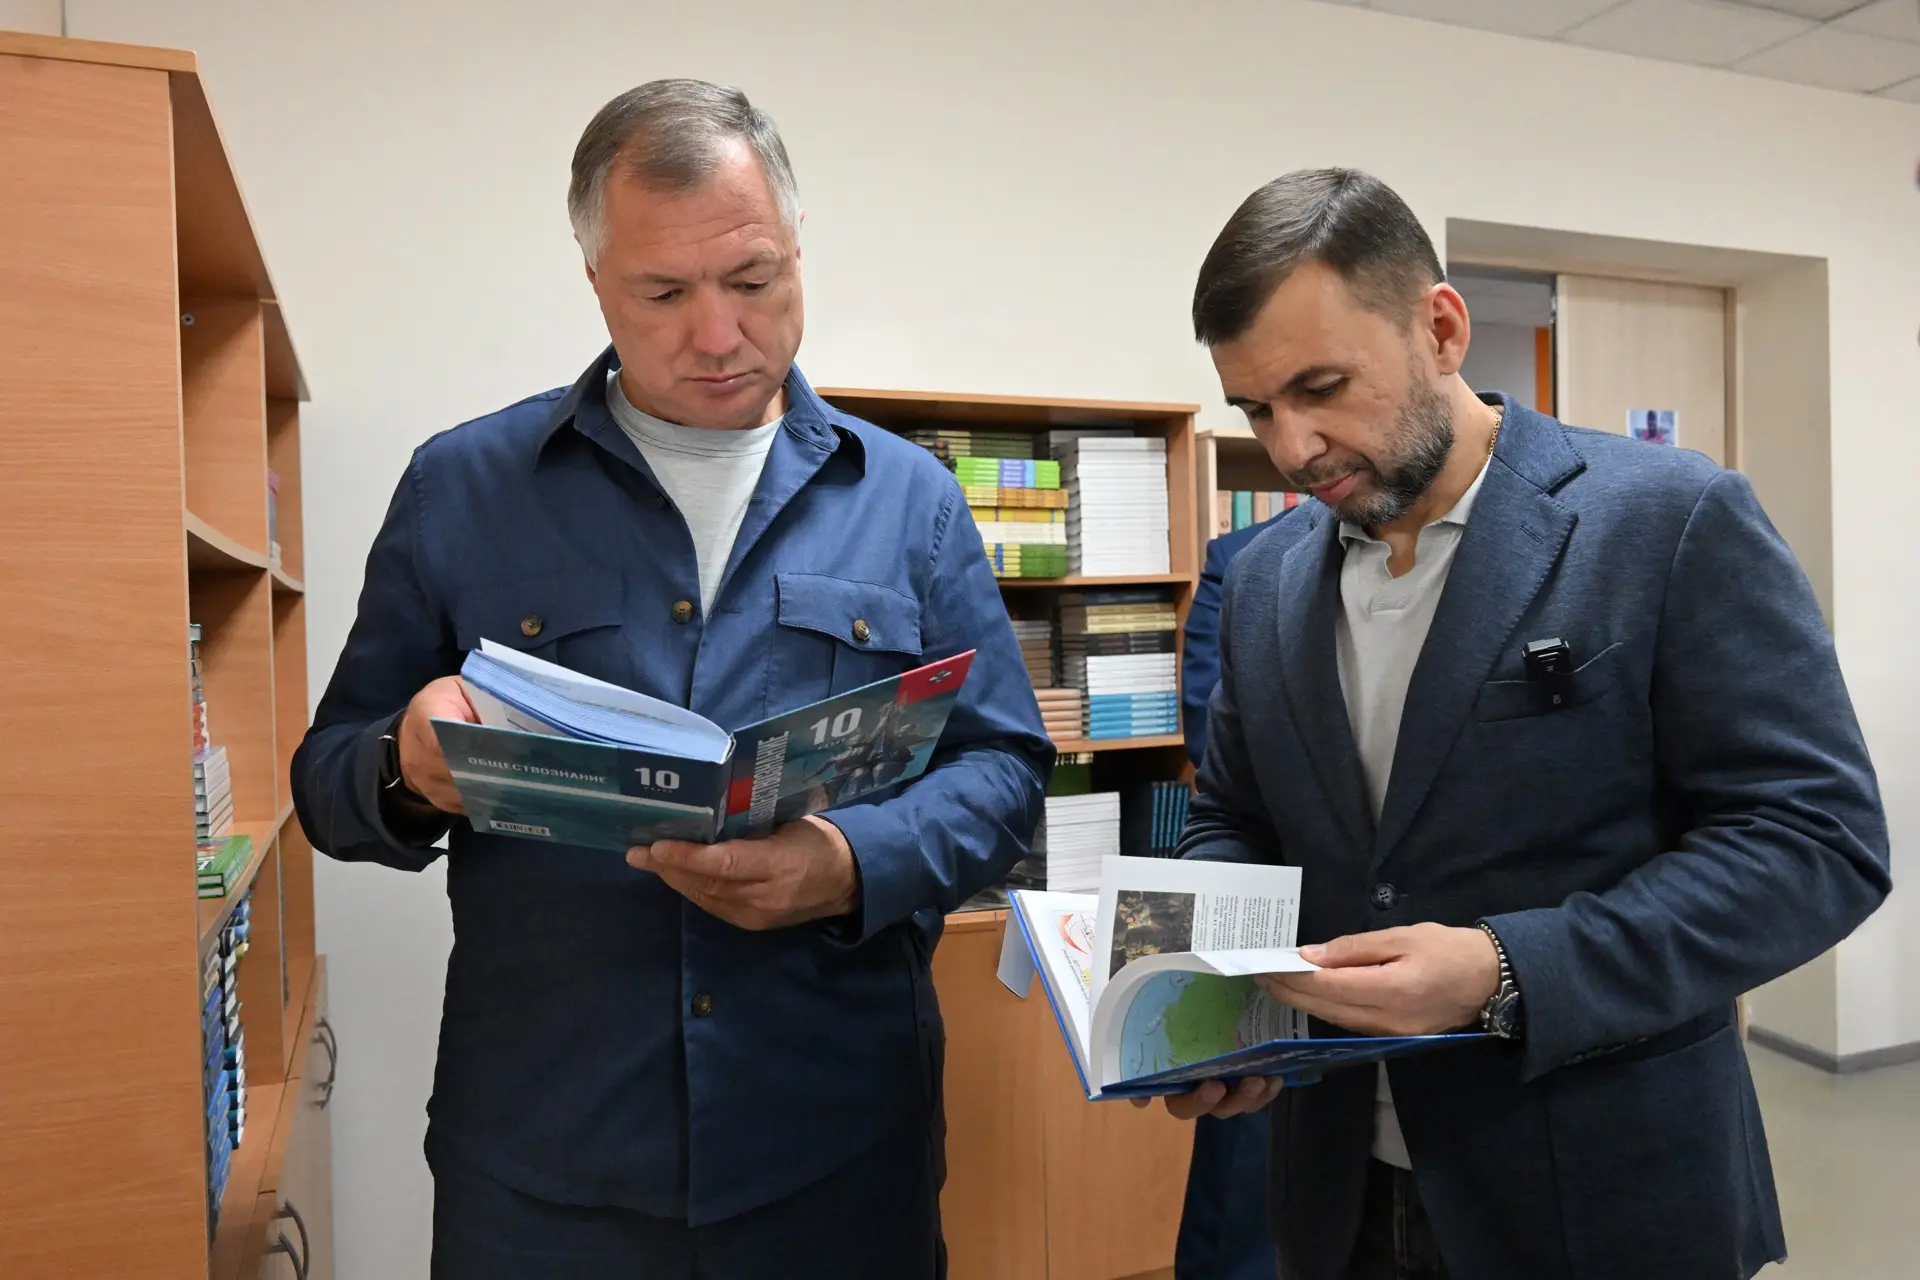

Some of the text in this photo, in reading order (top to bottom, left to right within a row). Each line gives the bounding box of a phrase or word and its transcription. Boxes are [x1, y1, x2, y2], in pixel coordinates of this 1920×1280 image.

[810, 707, 863, 746] 10
[467, 756, 607, 783] ОБЩЕСТВОЗНАНИЕ
[634, 767, 680, 790] 10
